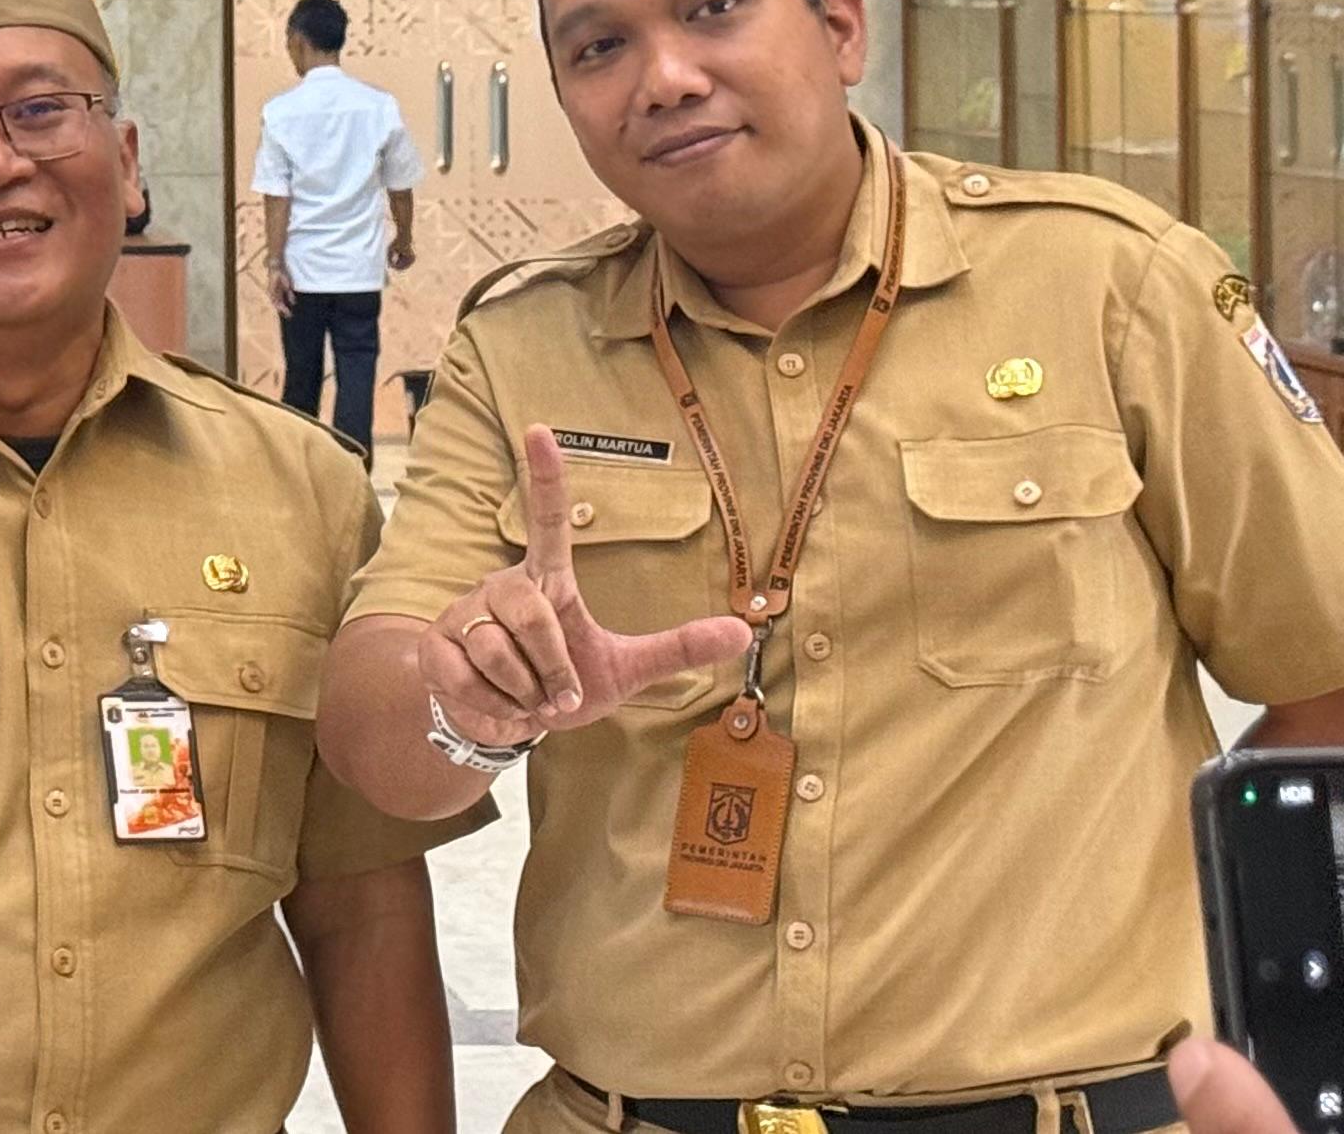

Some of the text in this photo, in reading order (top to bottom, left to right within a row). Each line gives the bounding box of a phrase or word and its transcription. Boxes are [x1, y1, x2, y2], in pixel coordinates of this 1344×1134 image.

[596, 437, 653, 455] MARTUA
[781, 501, 809, 569] PEMERINTAH
[827, 384, 854, 433] JAKARTA
[732, 537, 749, 590] JAKARTA
